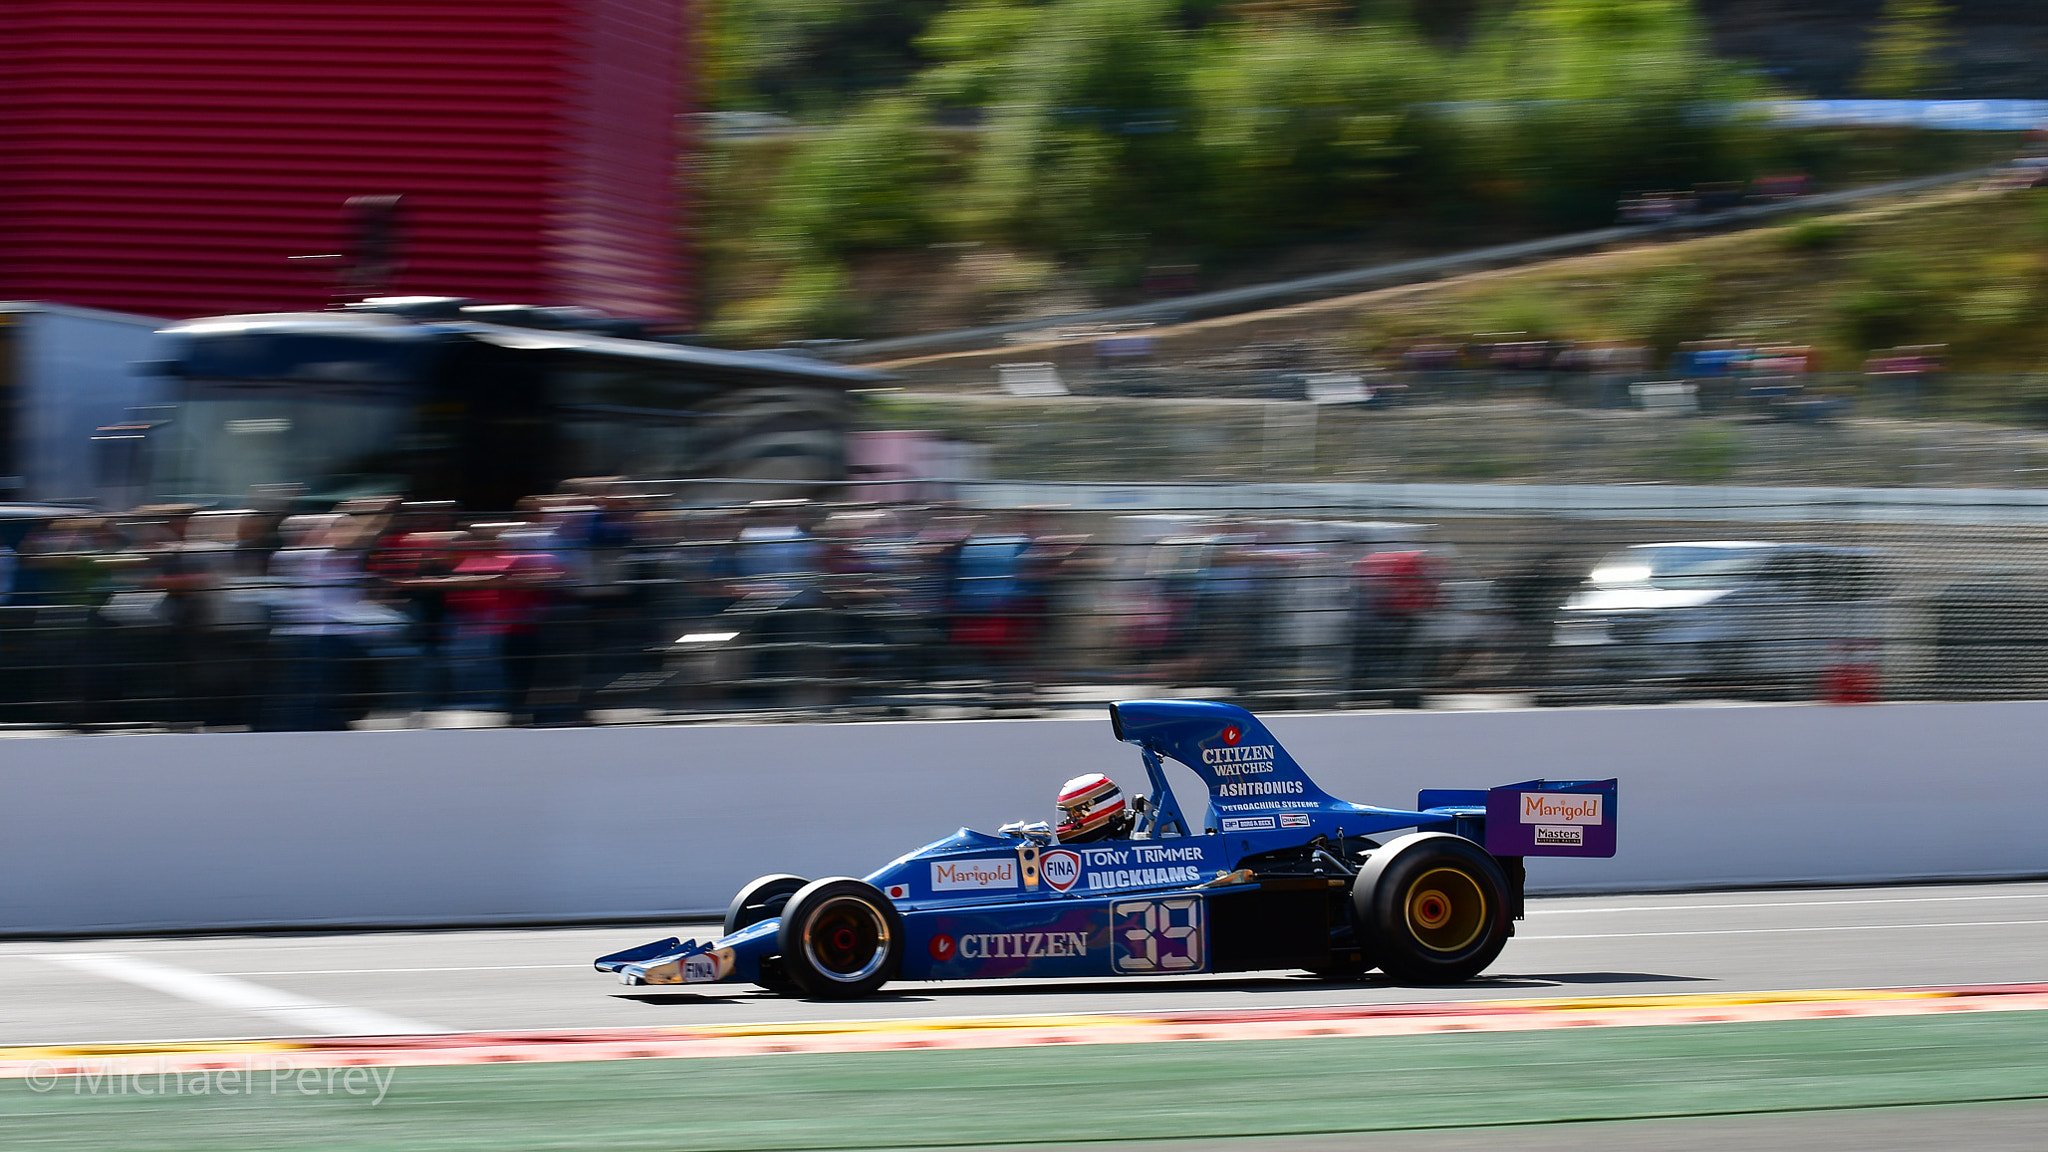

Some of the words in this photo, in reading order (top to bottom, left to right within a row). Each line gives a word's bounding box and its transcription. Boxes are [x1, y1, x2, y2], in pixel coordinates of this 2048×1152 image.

[1202, 745, 1275, 764] CITIZEN
[1212, 761, 1274, 776] WATCHES
[1219, 781, 1303, 797] ASHTRONICS
[1281, 800, 1320, 809] SYSTEMS
[1525, 796, 1598, 821] Marigold
[1538, 828, 1580, 838] Masters
[936, 863, 1012, 886] Marigold
[1046, 859, 1075, 878] FINA
[1088, 866, 1201, 890] DUCKHAMS
[1115, 900, 1197, 969] 39
[959, 931, 1089, 959] CITIZEN
[685, 962, 715, 978] FINA
